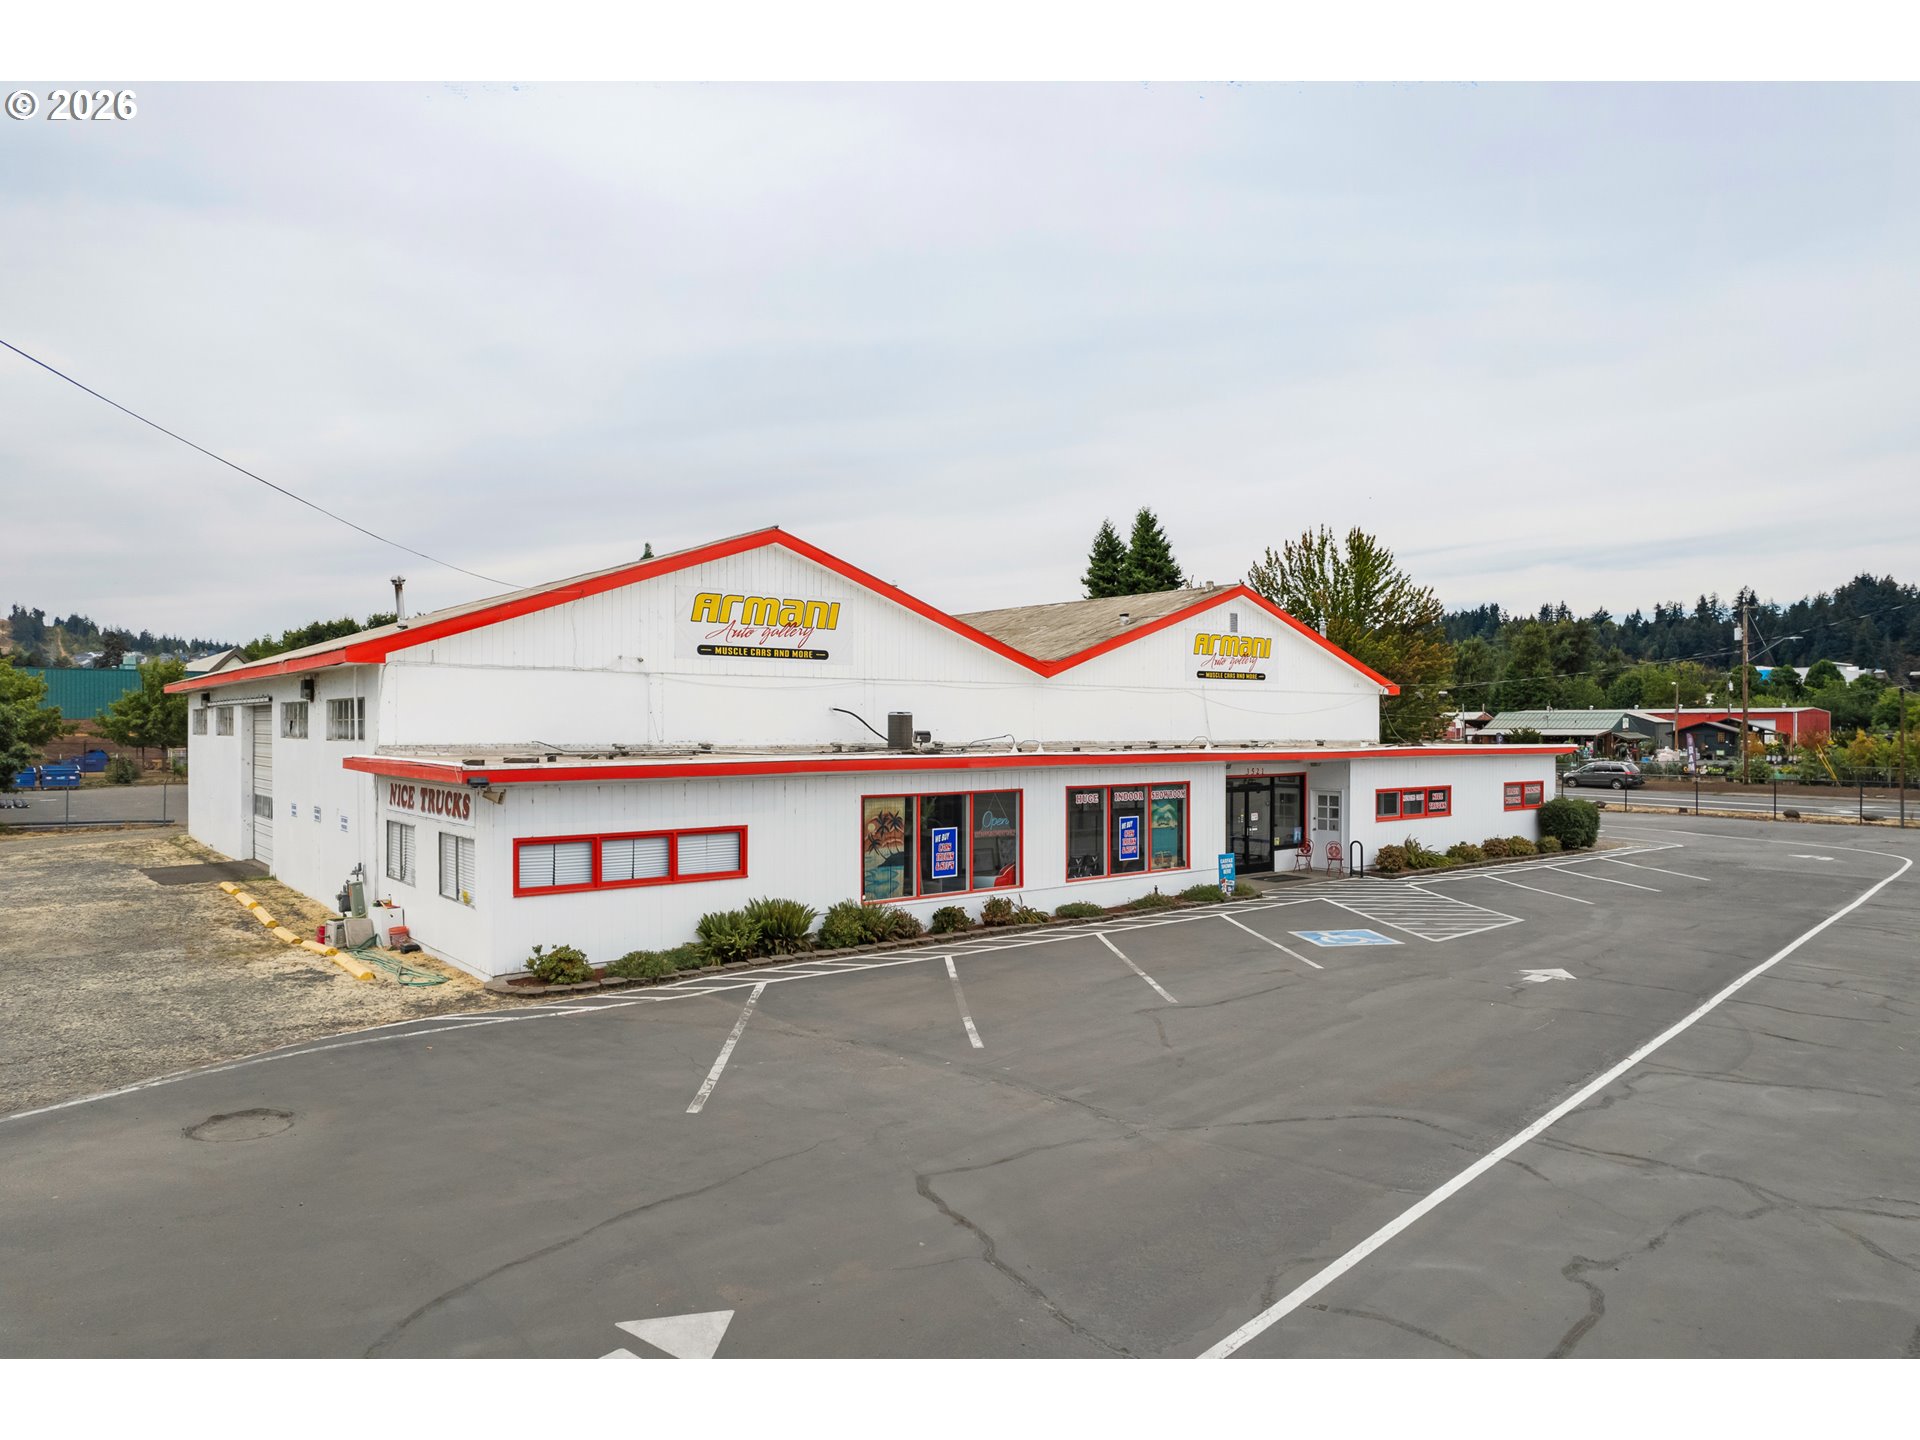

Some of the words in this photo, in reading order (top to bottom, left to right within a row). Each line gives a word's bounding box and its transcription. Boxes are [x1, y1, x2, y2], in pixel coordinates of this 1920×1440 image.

[705, 619, 755, 643] Auto
[715, 646, 748, 656] MUSCLE
[750, 647, 771, 657] CARS
[774, 648, 790, 658] AND
[792, 649, 813, 659] MORE
[389, 782, 415, 810] NICE
[420, 787, 471, 821] TRUCKS
[1075, 793, 1099, 804] HUGE
[1114, 791, 1144, 801] INDOOR
[982, 810, 1009, 831] Open
